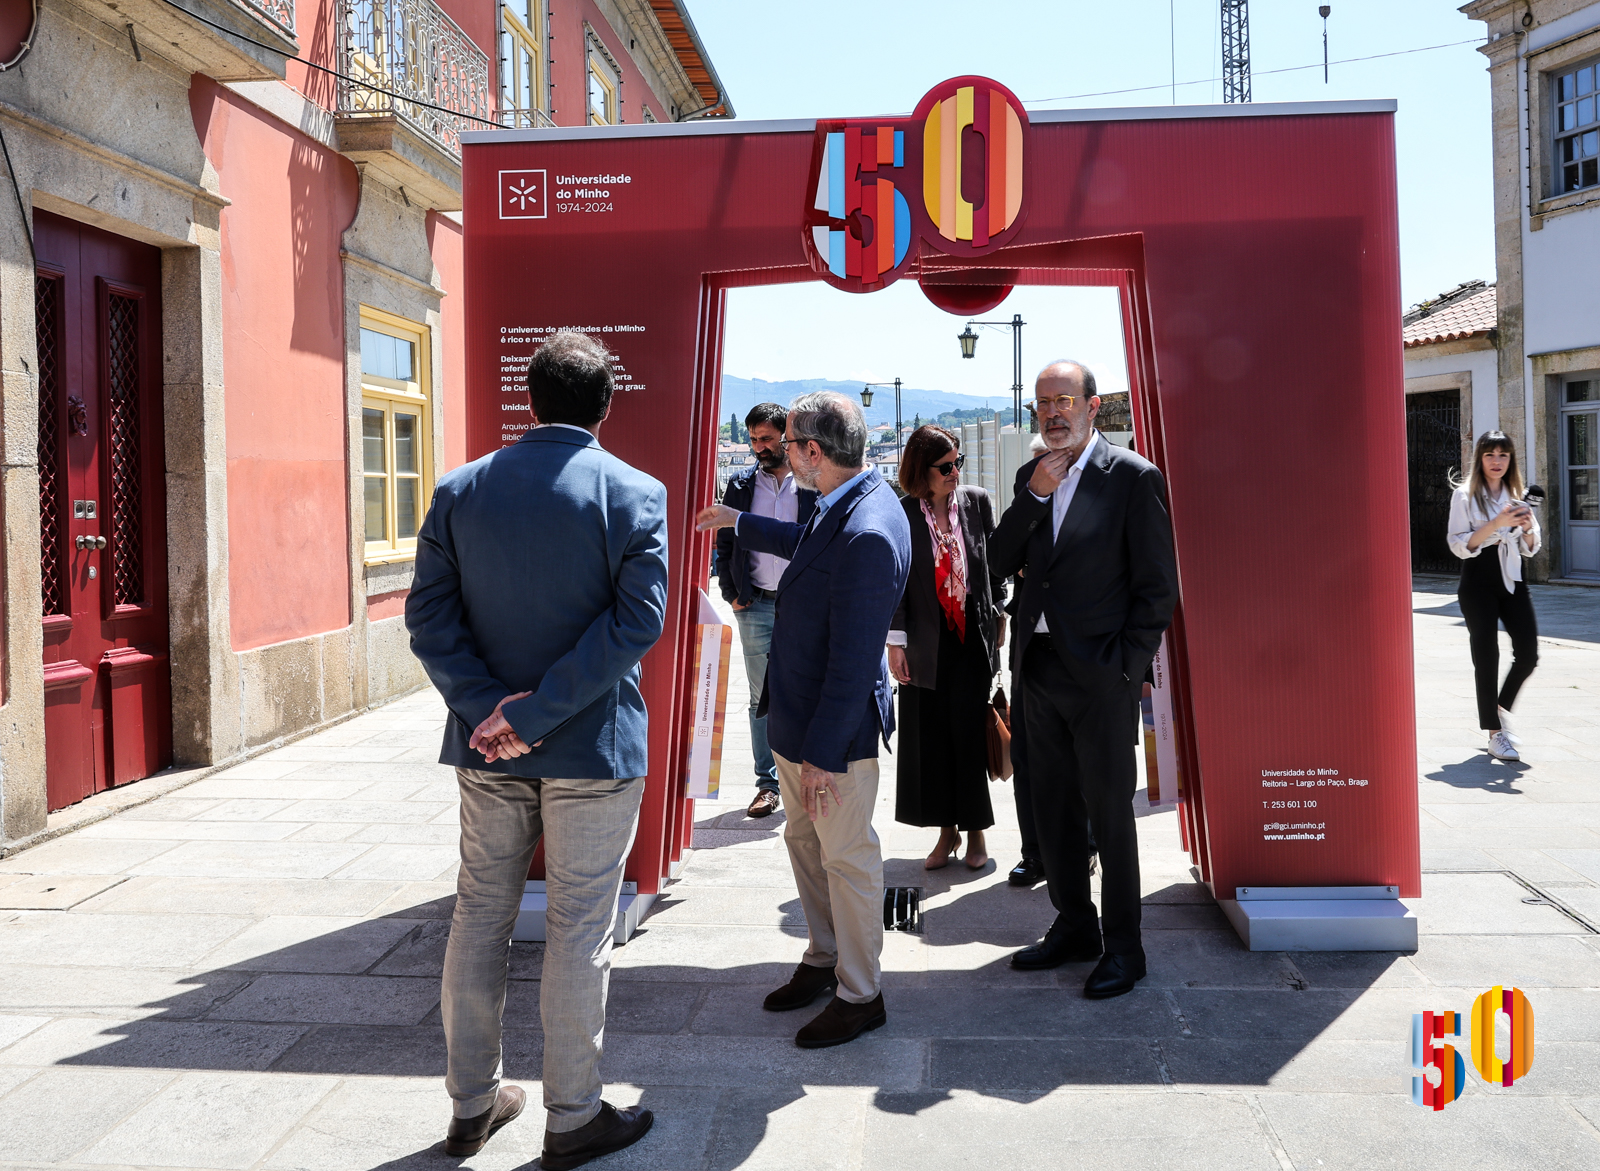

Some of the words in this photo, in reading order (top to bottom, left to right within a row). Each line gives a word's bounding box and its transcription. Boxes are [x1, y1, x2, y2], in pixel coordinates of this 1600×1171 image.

[556, 174, 631, 185] Universidade
[811, 86, 1023, 284] 50
[556, 189, 572, 198] do
[574, 188, 610, 198] Minho
[556, 202, 613, 212] 1974-2024
[558, 325, 600, 333] atividades
[502, 423, 529, 431] Arquivo
[702, 688, 710, 721] Universidade
[1262, 769, 1305, 777] Universidade
[1296, 780, 1315, 788] Largo
[1327, 779, 1346, 787] Paço,
[1348, 778, 1368, 786] Braga
[1263, 822, 1326, 831] gci@gci.uminho.pt
